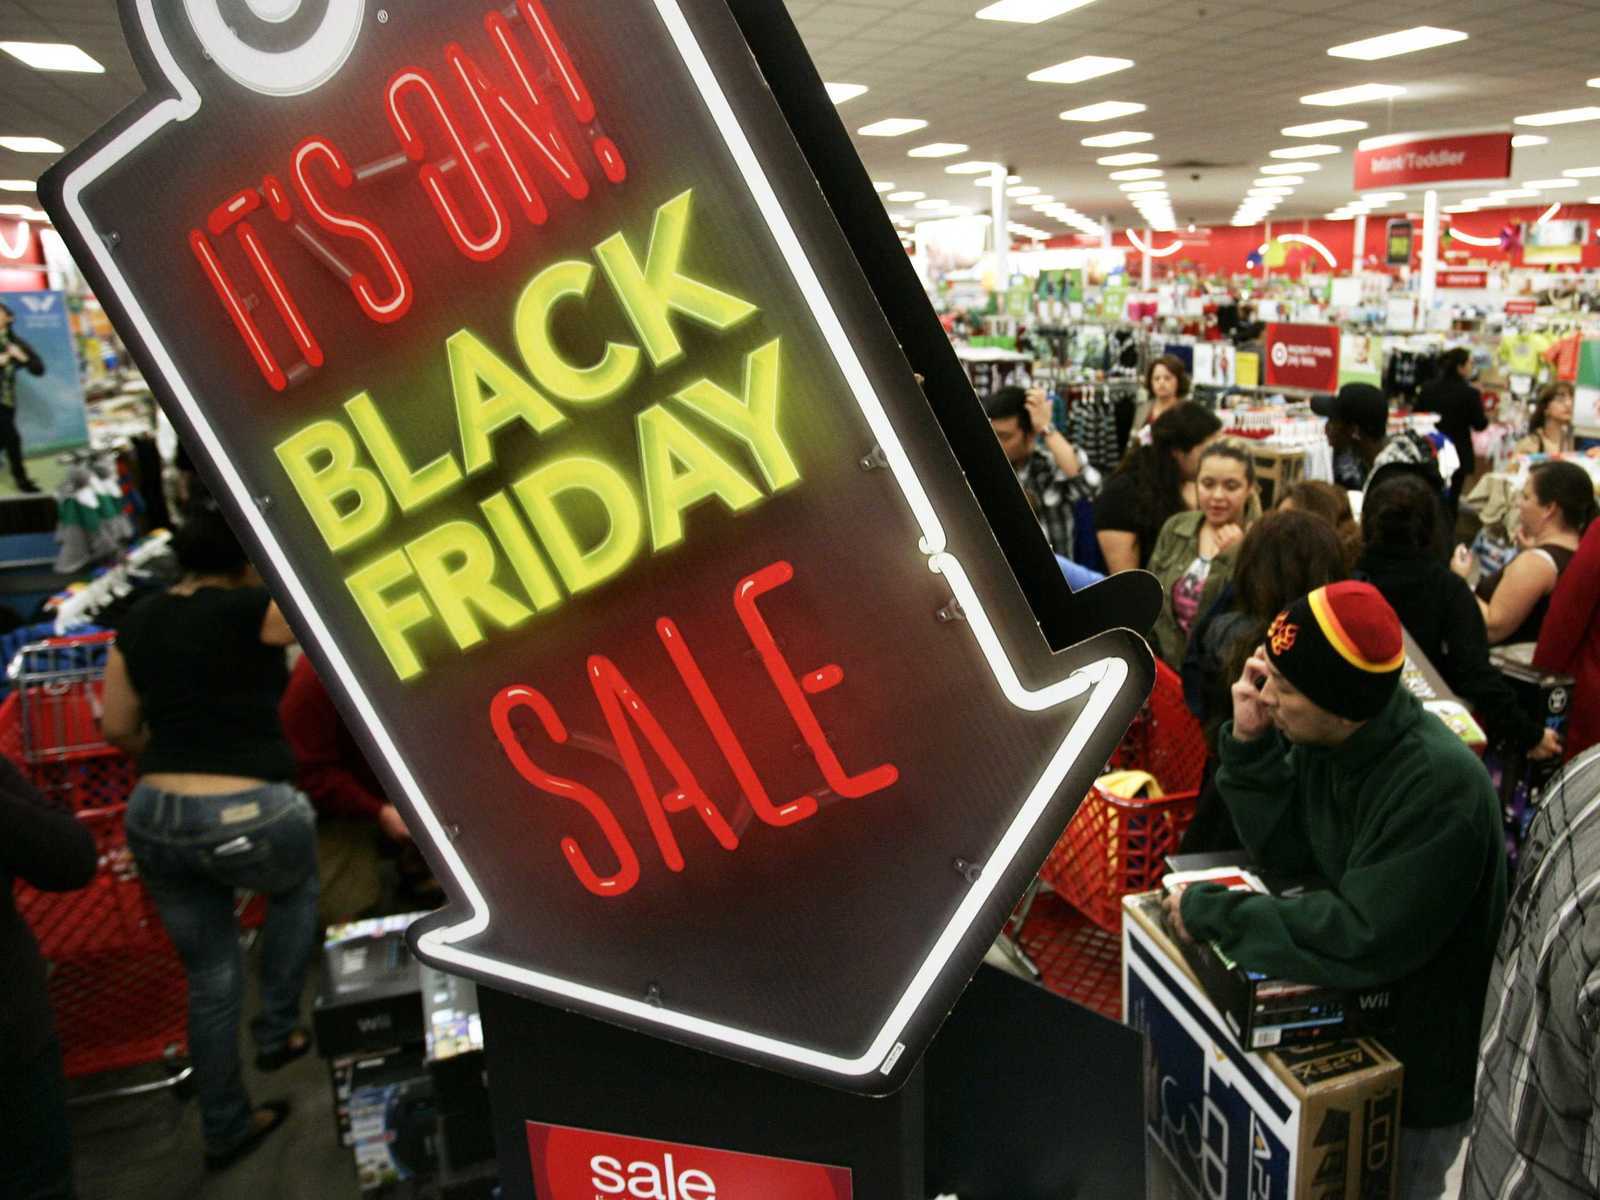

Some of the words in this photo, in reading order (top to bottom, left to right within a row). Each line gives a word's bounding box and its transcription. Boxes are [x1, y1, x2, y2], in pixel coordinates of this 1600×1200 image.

[189, 136, 412, 391] IT'S
[384, 0, 626, 262] ON!
[273, 188, 759, 552] BLACK
[344, 337, 801, 681] FRIDAY
[490, 560, 898, 897] SALE
[1358, 992, 1390, 1011] Wii
[590, 1152, 716, 1200] sale
